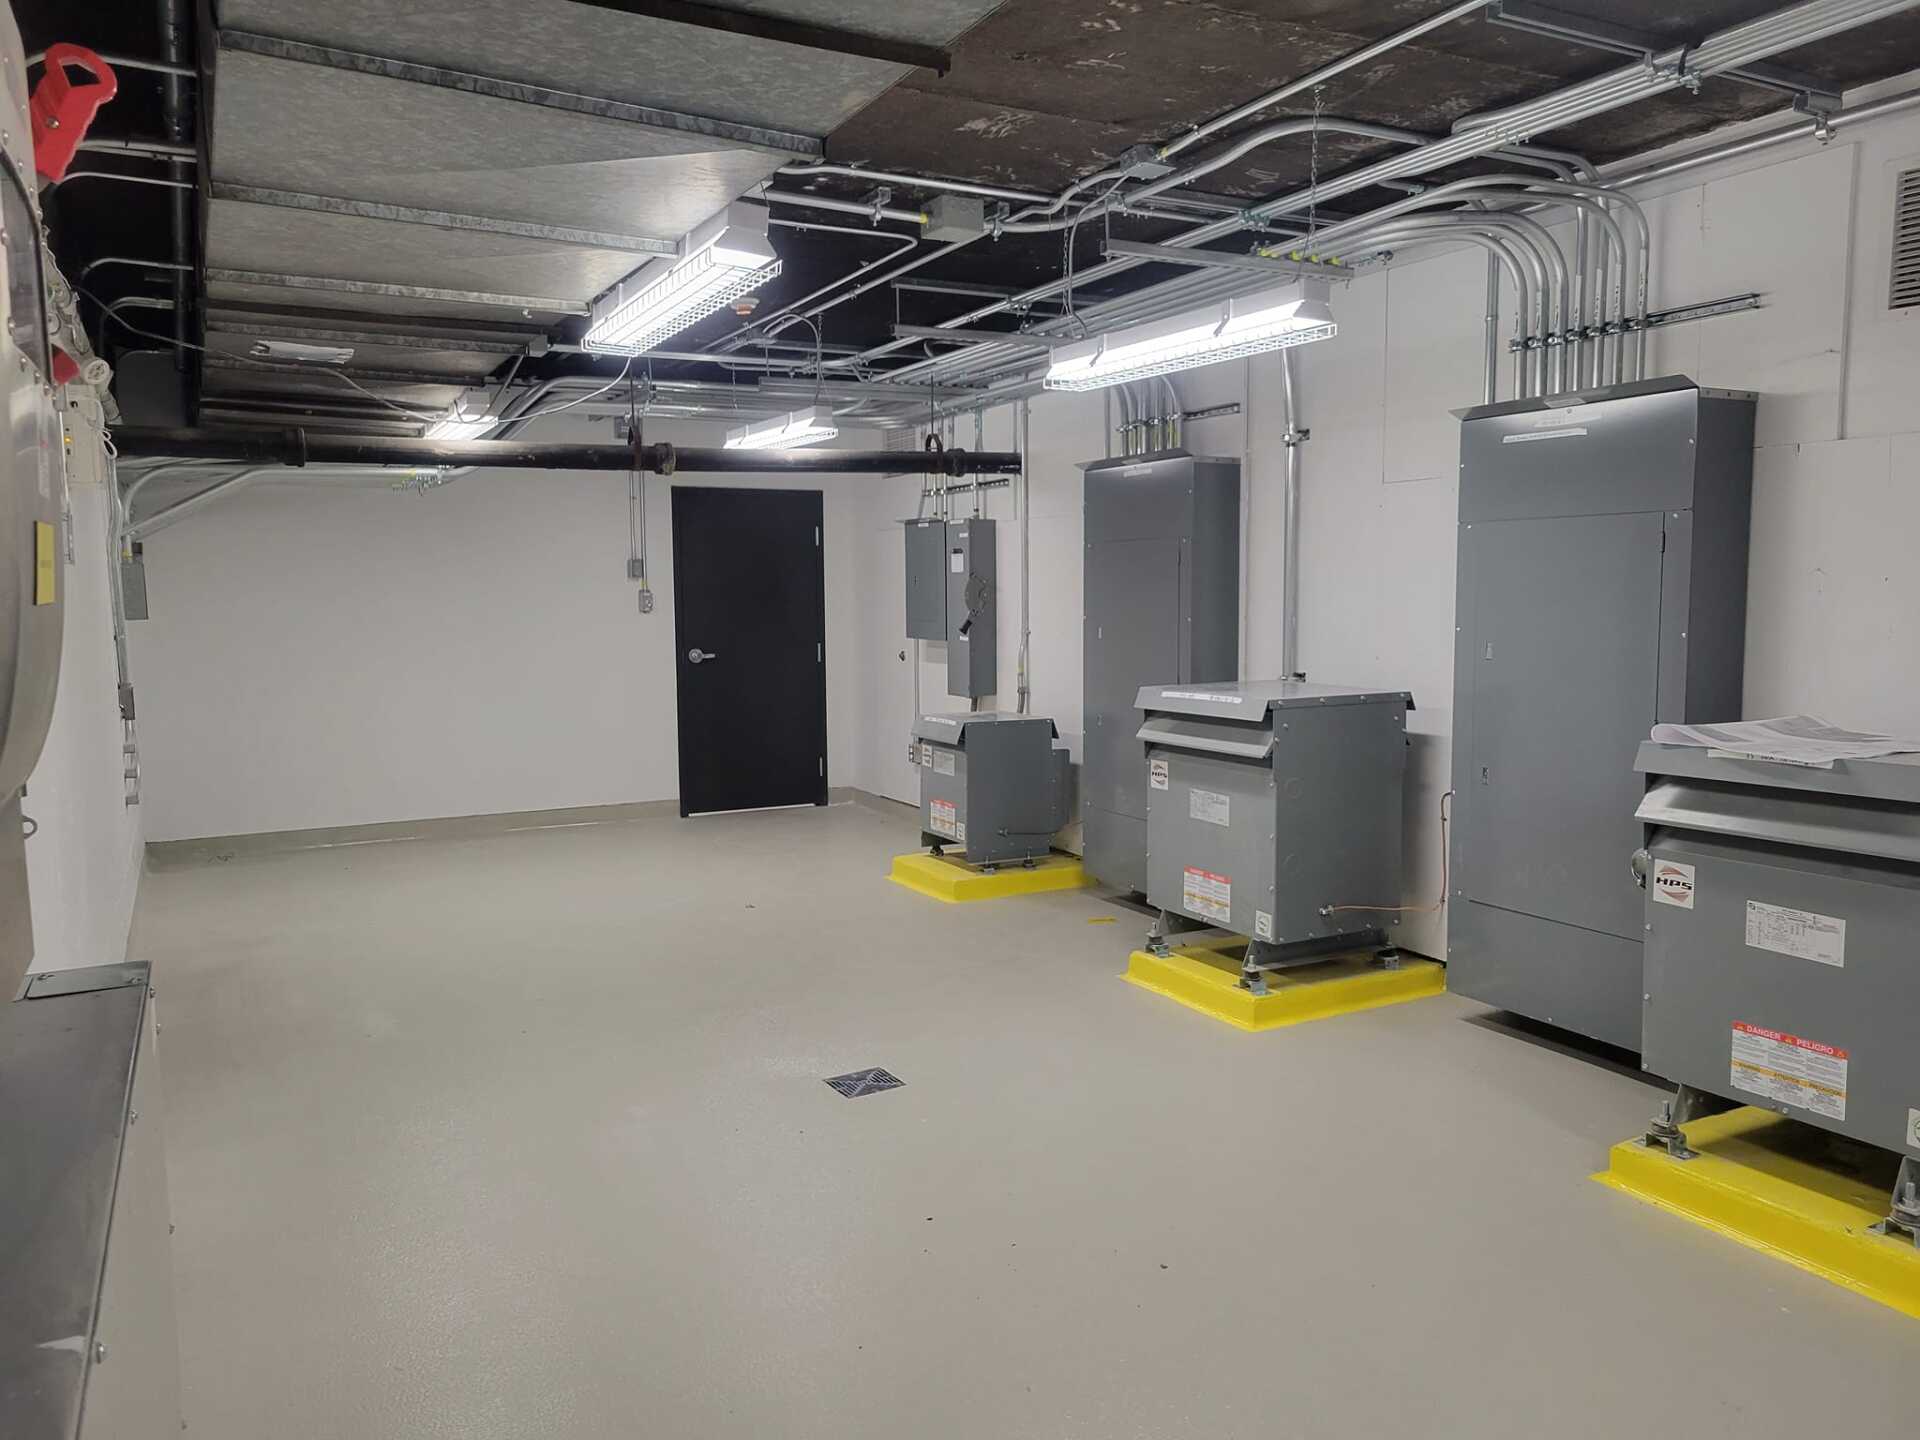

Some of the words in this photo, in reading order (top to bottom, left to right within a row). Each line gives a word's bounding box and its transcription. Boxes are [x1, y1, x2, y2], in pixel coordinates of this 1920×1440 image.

[1656, 876, 1692, 890] HPS
[1746, 1025, 1781, 1041] DANGER
[1796, 1038, 1834, 1055] PELIGRO
